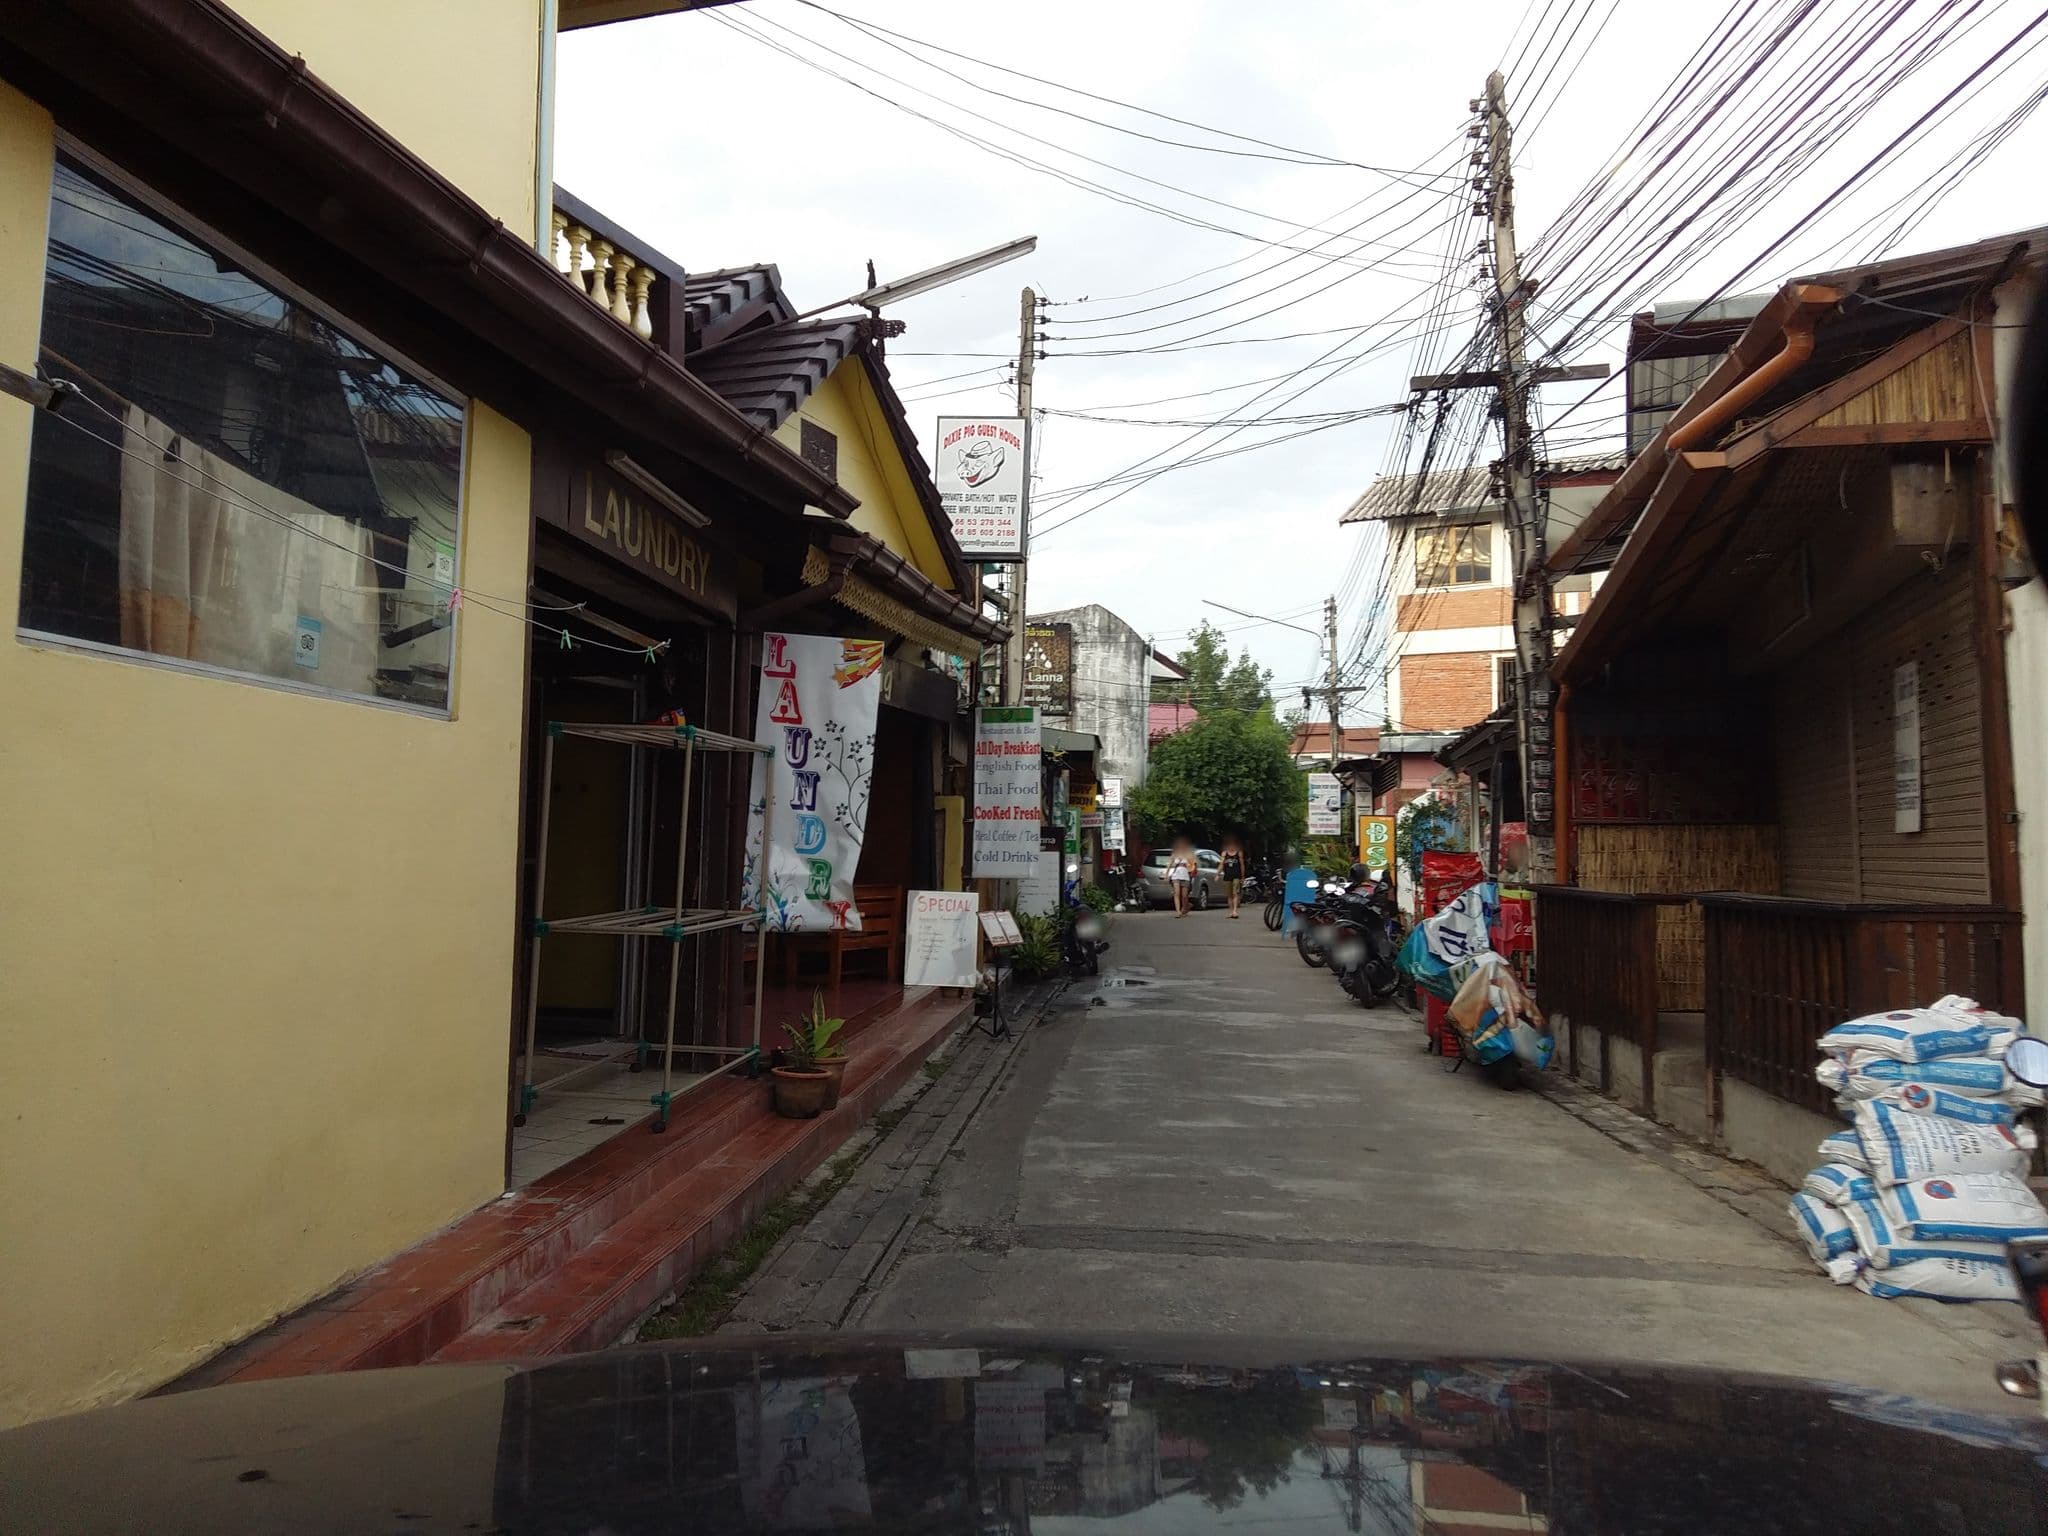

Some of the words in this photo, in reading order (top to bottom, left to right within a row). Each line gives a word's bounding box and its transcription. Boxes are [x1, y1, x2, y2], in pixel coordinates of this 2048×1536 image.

[944, 428, 962, 450] DIXIE
[964, 425, 976, 439] PIG
[977, 424, 997, 438] GUEST
[999, 427, 1021, 451] HOUSE
[998, 494, 1018, 503] WATER
[1006, 506, 1016, 515] TV
[584, 470, 711, 596] LAUNDRY
[1028, 671, 1063, 682] Lanna
[976, 741, 988, 755] All
[988, 741, 1002, 757] Day
[1004, 741, 1041, 755] Breakfast
[976, 760, 1012, 774] English
[1015, 760, 1041, 771] Food
[763, 634, 850, 931] LAUNDRY
[975, 782, 1003, 795] Thai
[1007, 782, 1039, 795] Food
[1014, 806, 1041, 820] Fresh
[992, 830, 1017, 842] Coffee
[1025, 830, 1040, 842] Tea
[975, 850, 999, 862] Cold
[1002, 850, 1039, 863] Drinks
[917, 896, 972, 912] SPECIAL
